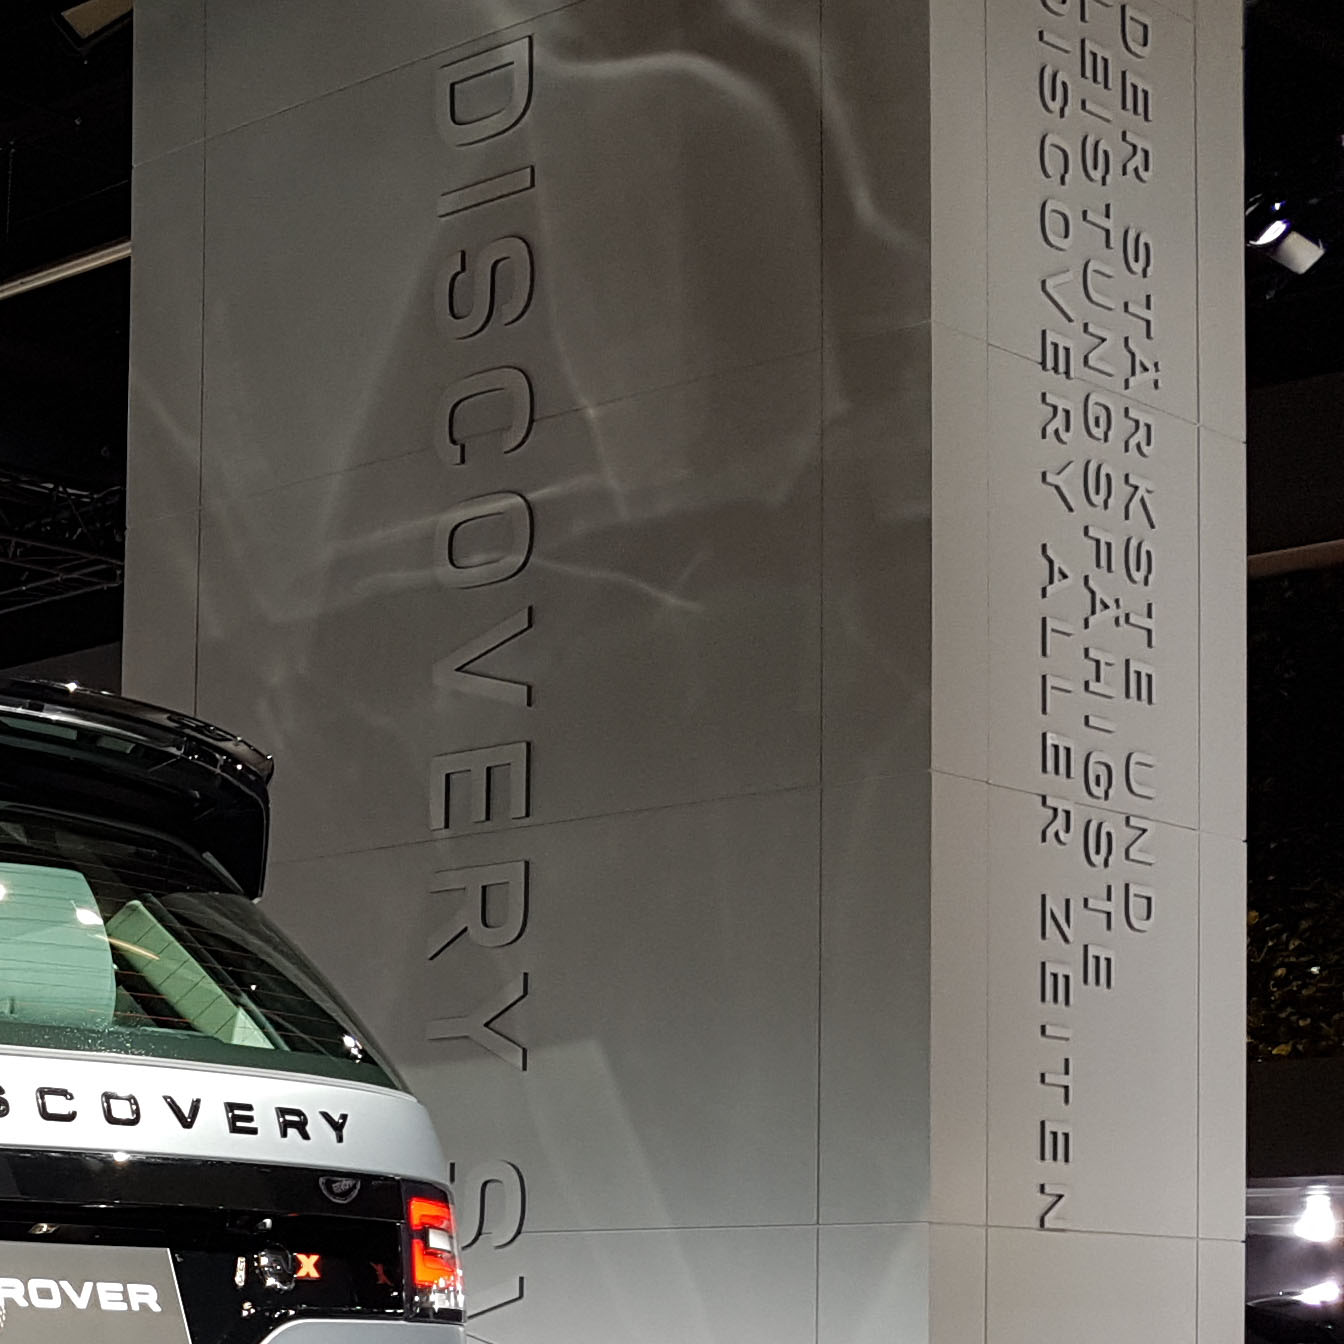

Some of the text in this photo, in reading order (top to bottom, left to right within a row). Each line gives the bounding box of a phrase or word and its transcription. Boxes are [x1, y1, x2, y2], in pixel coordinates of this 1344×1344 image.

[426, 34, 535, 1072] DISCOVERY
[1040, 543, 1074, 845] ALLER
[1120, 4, 1159, 933] DER STÄRKSTE UND
[1039, 893, 1072, 1230] ZEITEN
